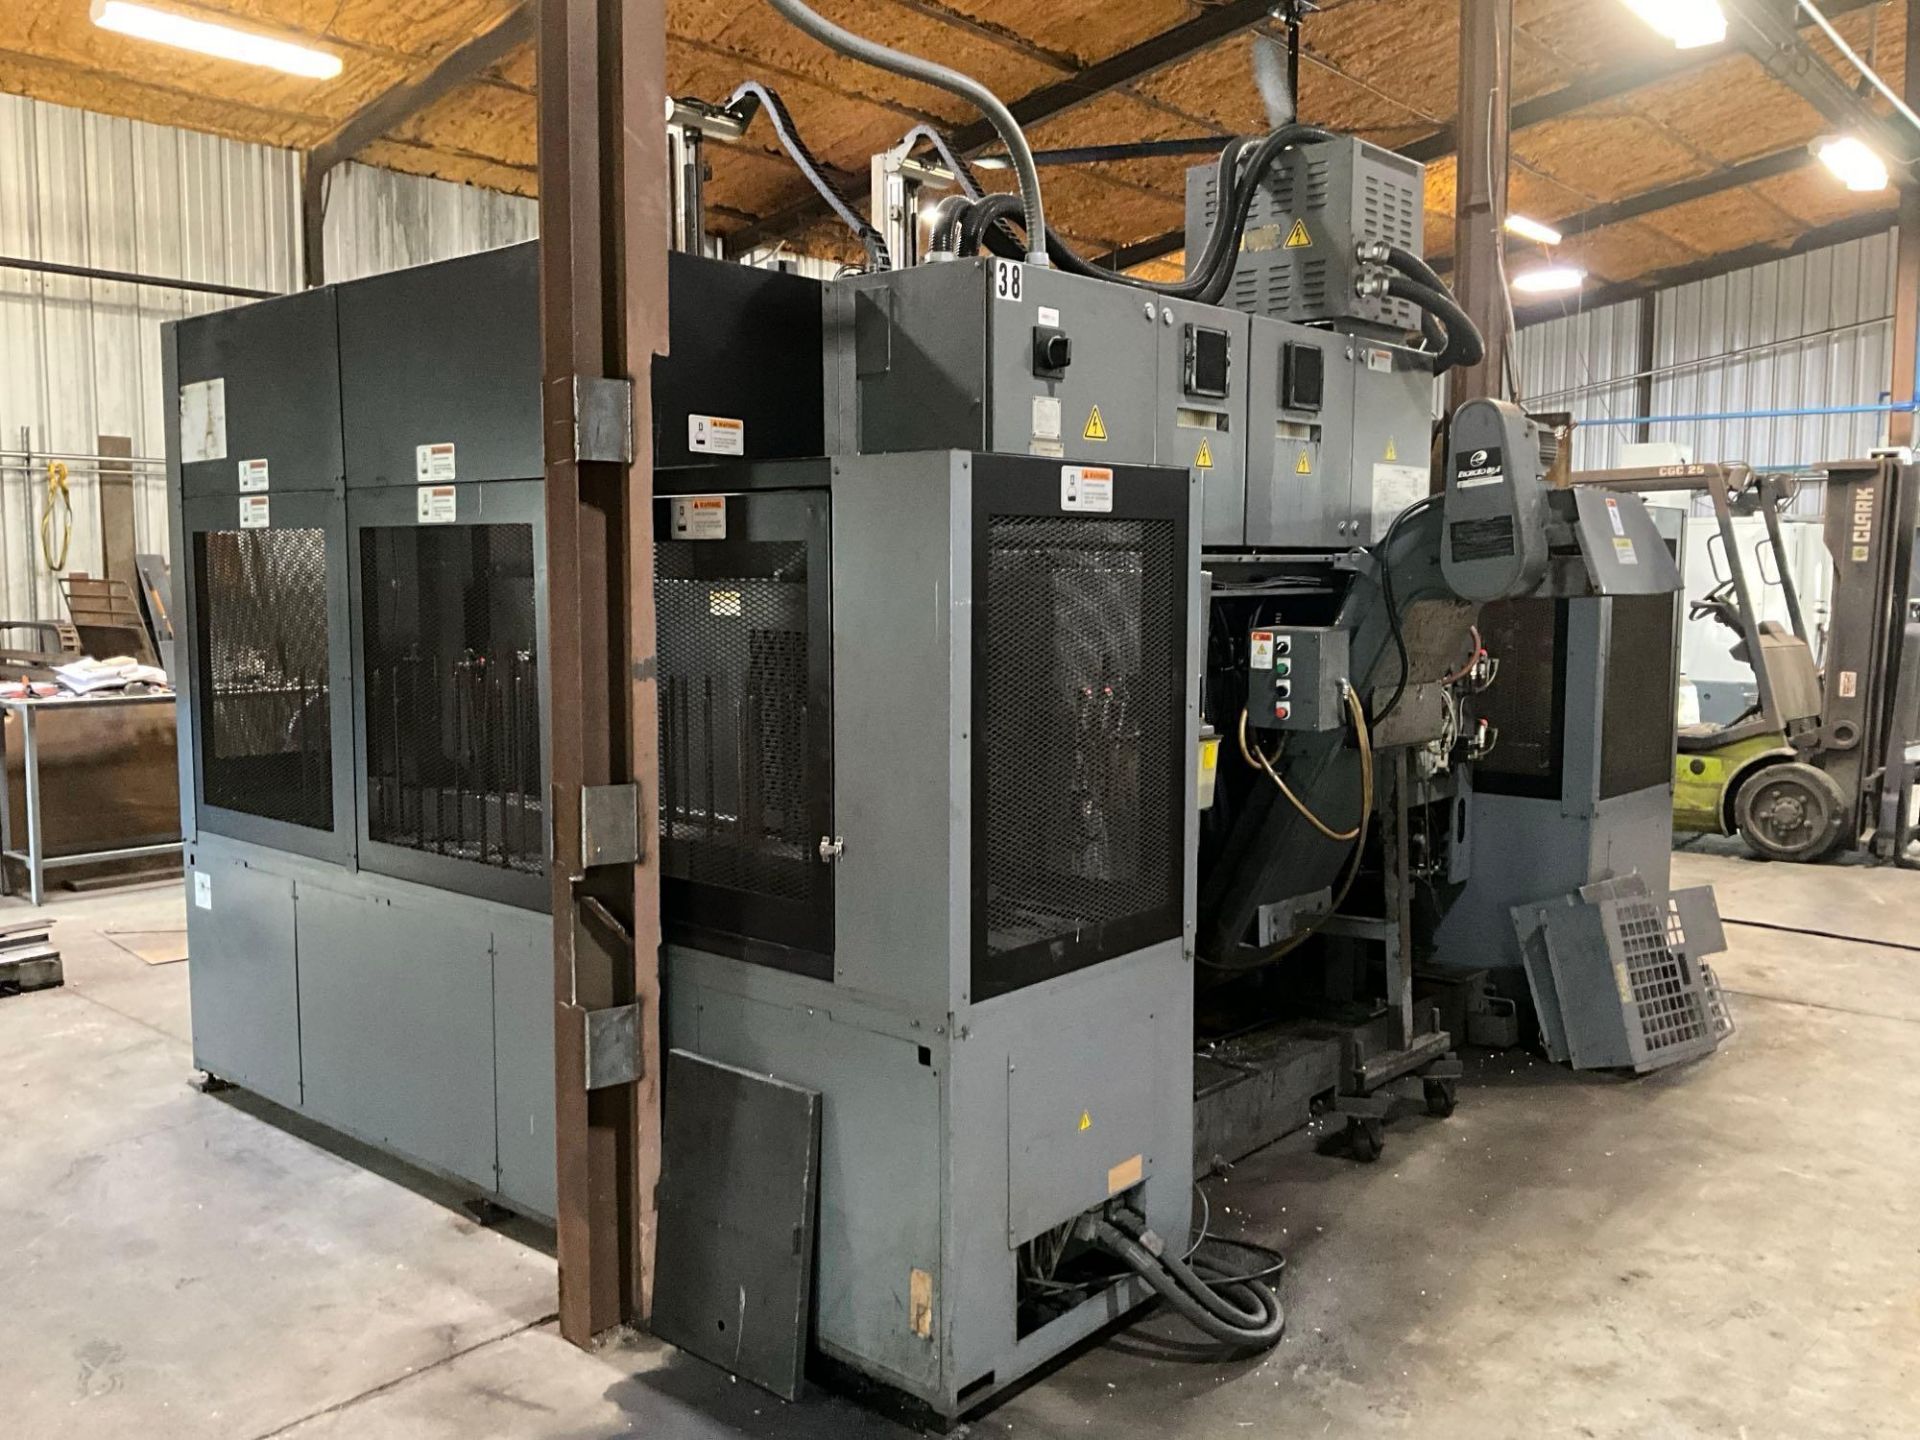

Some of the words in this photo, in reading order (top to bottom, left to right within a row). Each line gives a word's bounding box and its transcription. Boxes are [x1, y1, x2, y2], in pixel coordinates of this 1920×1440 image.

[999, 262, 1020, 299] 38
[1659, 465, 1684, 477] CGC
[1687, 464, 1705, 475] 25
[1853, 488, 1875, 543] CLARK
